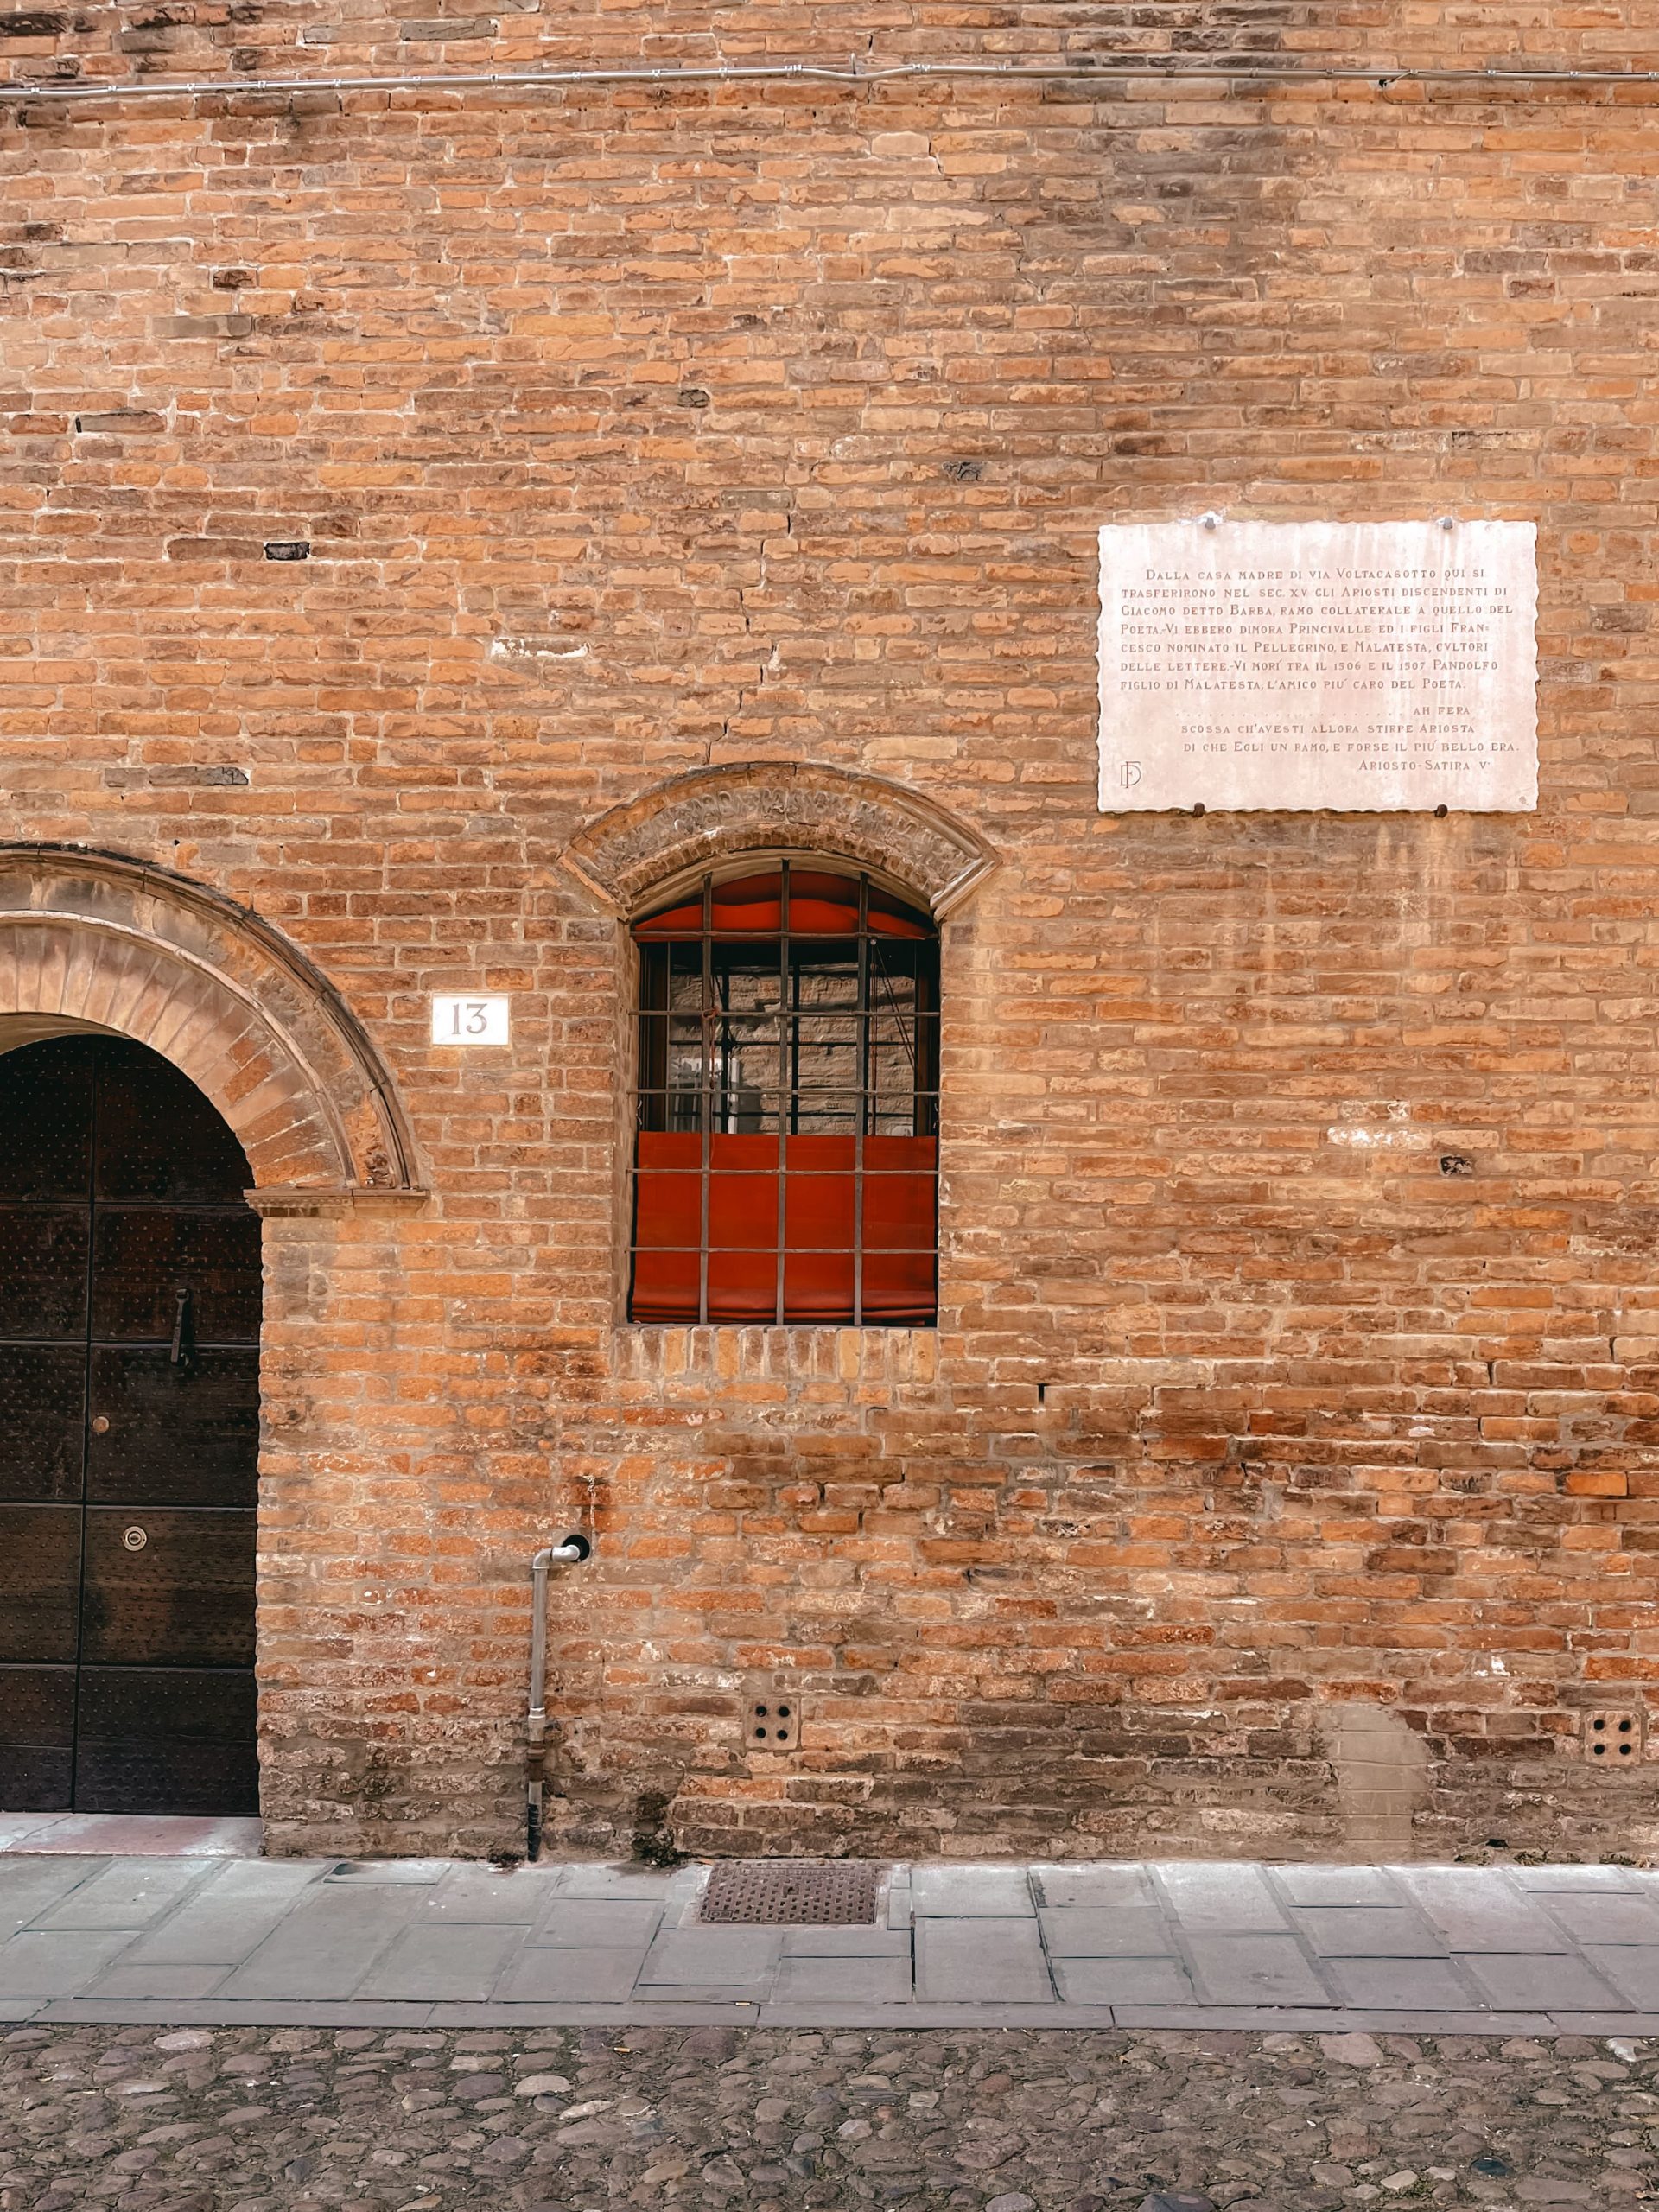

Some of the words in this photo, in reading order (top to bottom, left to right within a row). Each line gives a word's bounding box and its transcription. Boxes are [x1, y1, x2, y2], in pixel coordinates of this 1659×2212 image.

[1146, 569, 1190, 581] DALLA
[1198, 571, 1232, 581] CASA
[1238, 570, 1283, 581] MADRE
[1289, 570, 1302, 580] DI
[1308, 570, 1331, 580] VIA
[1335, 567, 1436, 579] VOLTACASOTTO
[1444, 569, 1465, 582] QUI
[1472, 569, 1484, 578] SI
[1121, 588, 1216, 599] TRASFERIRONO
[1224, 588, 1250, 599] NEL
[1259, 588, 1286, 598] SEC.
[1288, 588, 1308, 598] XV
[1314, 588, 1335, 598] GLI
[1340, 586, 1395, 598] ARIOSTI
[1401, 587, 1488, 598] DISCENDENTI
[1494, 587, 1507, 596] DI
[1121, 604, 1176, 616] GIACOMO
[1182, 607, 1224, 616] DETTO
[1230, 603, 1276, 617] BARBA,
[1280, 606, 1313, 616] RAMO
[1320, 605, 1411, 616] COLLATERALE
[1417, 606, 1426, 615] A
[1432, 605, 1482, 617] QUELLO
[1489, 605, 1513, 614] DEL
[1185, 625, 1233, 635] EBBERO
[1239, 625, 1283, 635] DIMORA
[1289, 622, 1372, 634] PRINCIVALLE
[1377, 624, 1395, 634] ED
[1400, 624, 1404, 634] I
[1409, 624, 1444, 634] FIGLI
[1121, 643, 1161, 653] CESCO
[1166, 643, 1230, 653] NOMINATO
[1236, 643, 1248, 653] IL
[1254, 641, 1337, 653] PELLEGRINO,
[1340, 643, 1349, 652] E
[1354, 640, 1432, 654] MALATESTA,
[1435, 642, 1488, 652] CVLTORI
[1120, 662, 1161, 671] DELLE
[1286, 662, 1310, 671] TRA
[1315, 661, 1328, 671] IL
[1333, 660, 1362, 671] 1506
[1368, 662, 1376, 671] E
[1382, 661, 1394, 671] IL
[1399, 661, 1426, 671] 1507
[1433, 658, 1498, 671] PANDOLFO
[1120, 681, 1160, 690] FIGLIO
[1166, 680, 1179, 690] DI
[1184, 678, 1264, 691] MALATESTA,
[1267, 679, 1317, 690] L'AMICO
[1352, 680, 1384, 690] CARO
[1391, 680, 1416, 690] DEL
[1422, 677, 1466, 690] POETA.
[1413, 706, 1430, 715] AH
[1438, 706, 1471, 715] FERA
[1181, 724, 1230, 734] SCOSSA
[1237, 722, 1304, 734] CH'AVESTI
[1310, 723, 1359, 734] ALLORA
[1367, 724, 1414, 734] STIRPE
[1419, 723, 1475, 734] ARIOSTA
[1184, 742, 1195, 753] DI
[1202, 742, 1228, 753] CHE
[1233, 741, 1264, 753] EGLI
[1270, 742, 1287, 753] UN
[1294, 742, 1329, 753] RAMO,
[1332, 742, 1341, 752] E
[1347, 742, 1389, 752] FORSE
[1395, 742, 1408, 752] IL
[1441, 742, 1484, 753] BELLO
[1490, 742, 1520, 752] ERA.
[451, 1003, 488, 1035] 13
